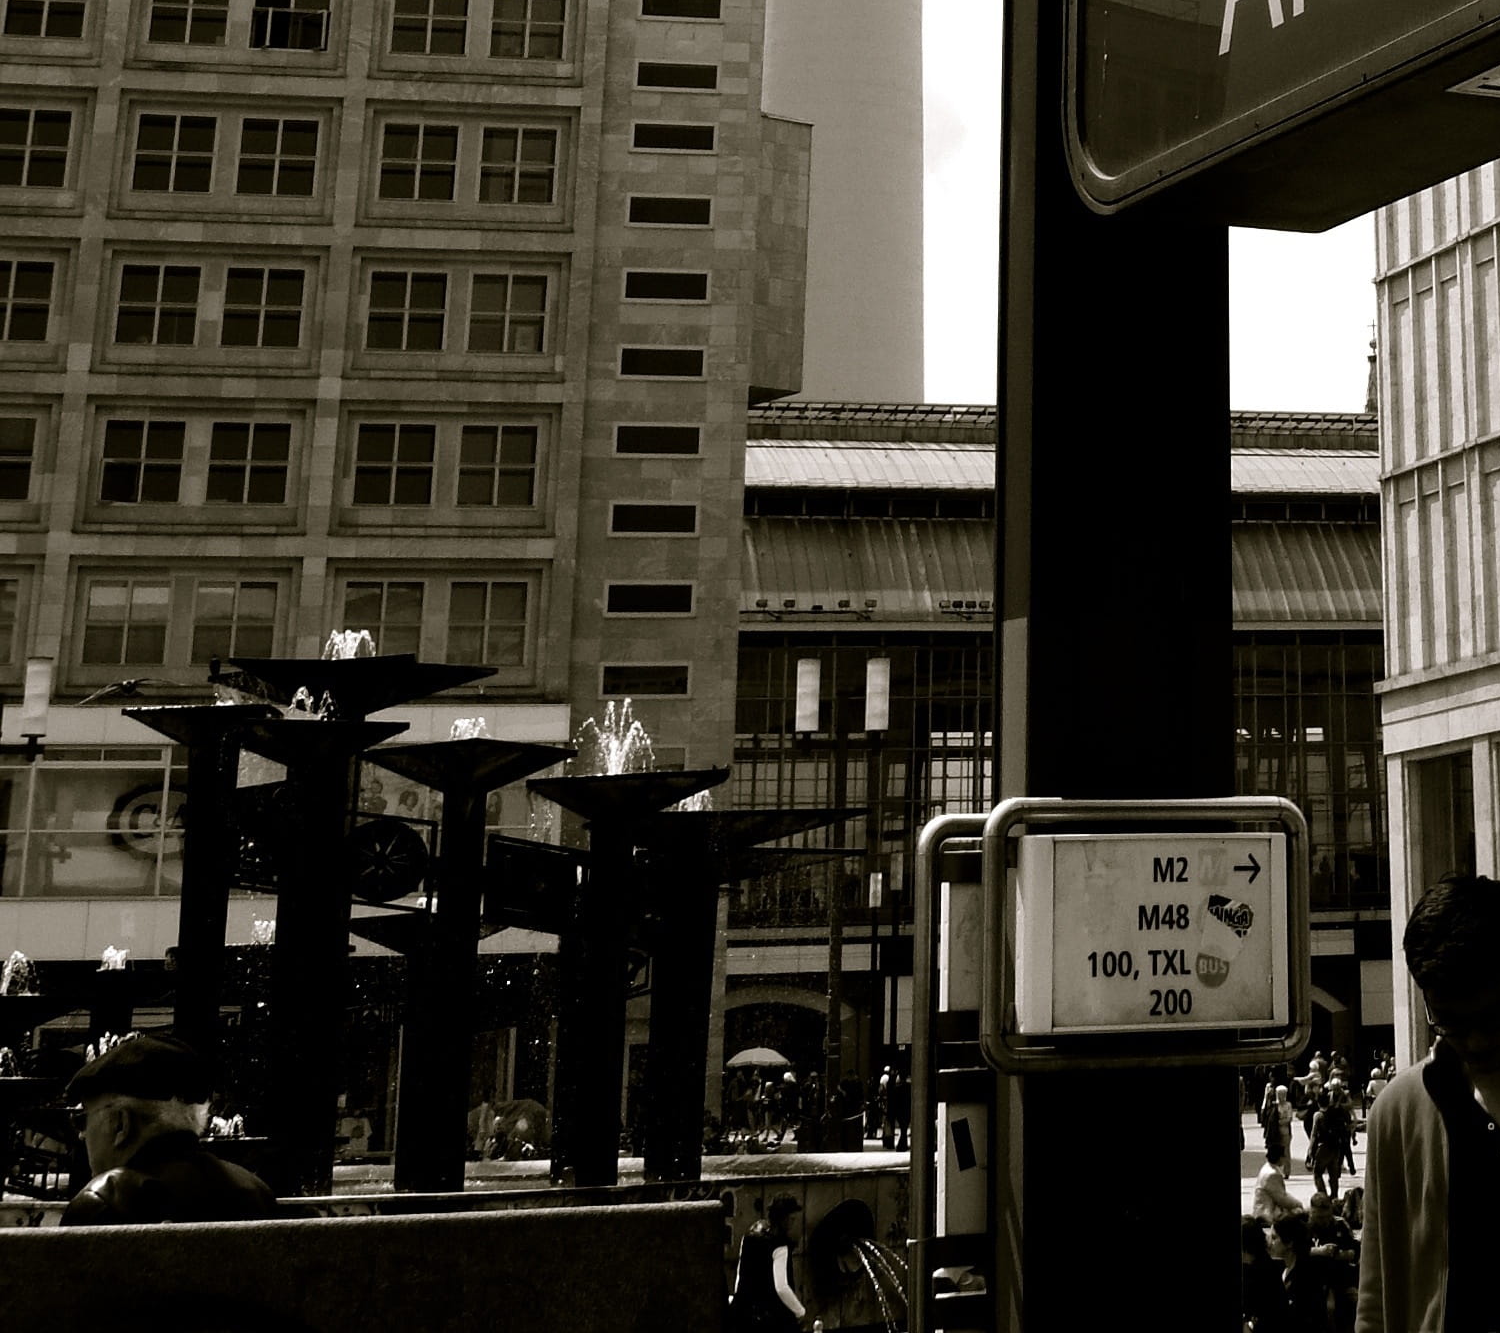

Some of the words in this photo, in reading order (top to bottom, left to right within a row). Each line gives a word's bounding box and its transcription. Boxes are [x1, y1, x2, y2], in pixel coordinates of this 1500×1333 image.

[1152, 857, 1189, 883] M2
[1138, 904, 1190, 931] M48
[1088, 951, 1140, 981] 100,
[1148, 950, 1191, 976] TXL
[1150, 989, 1193, 1017] 200
